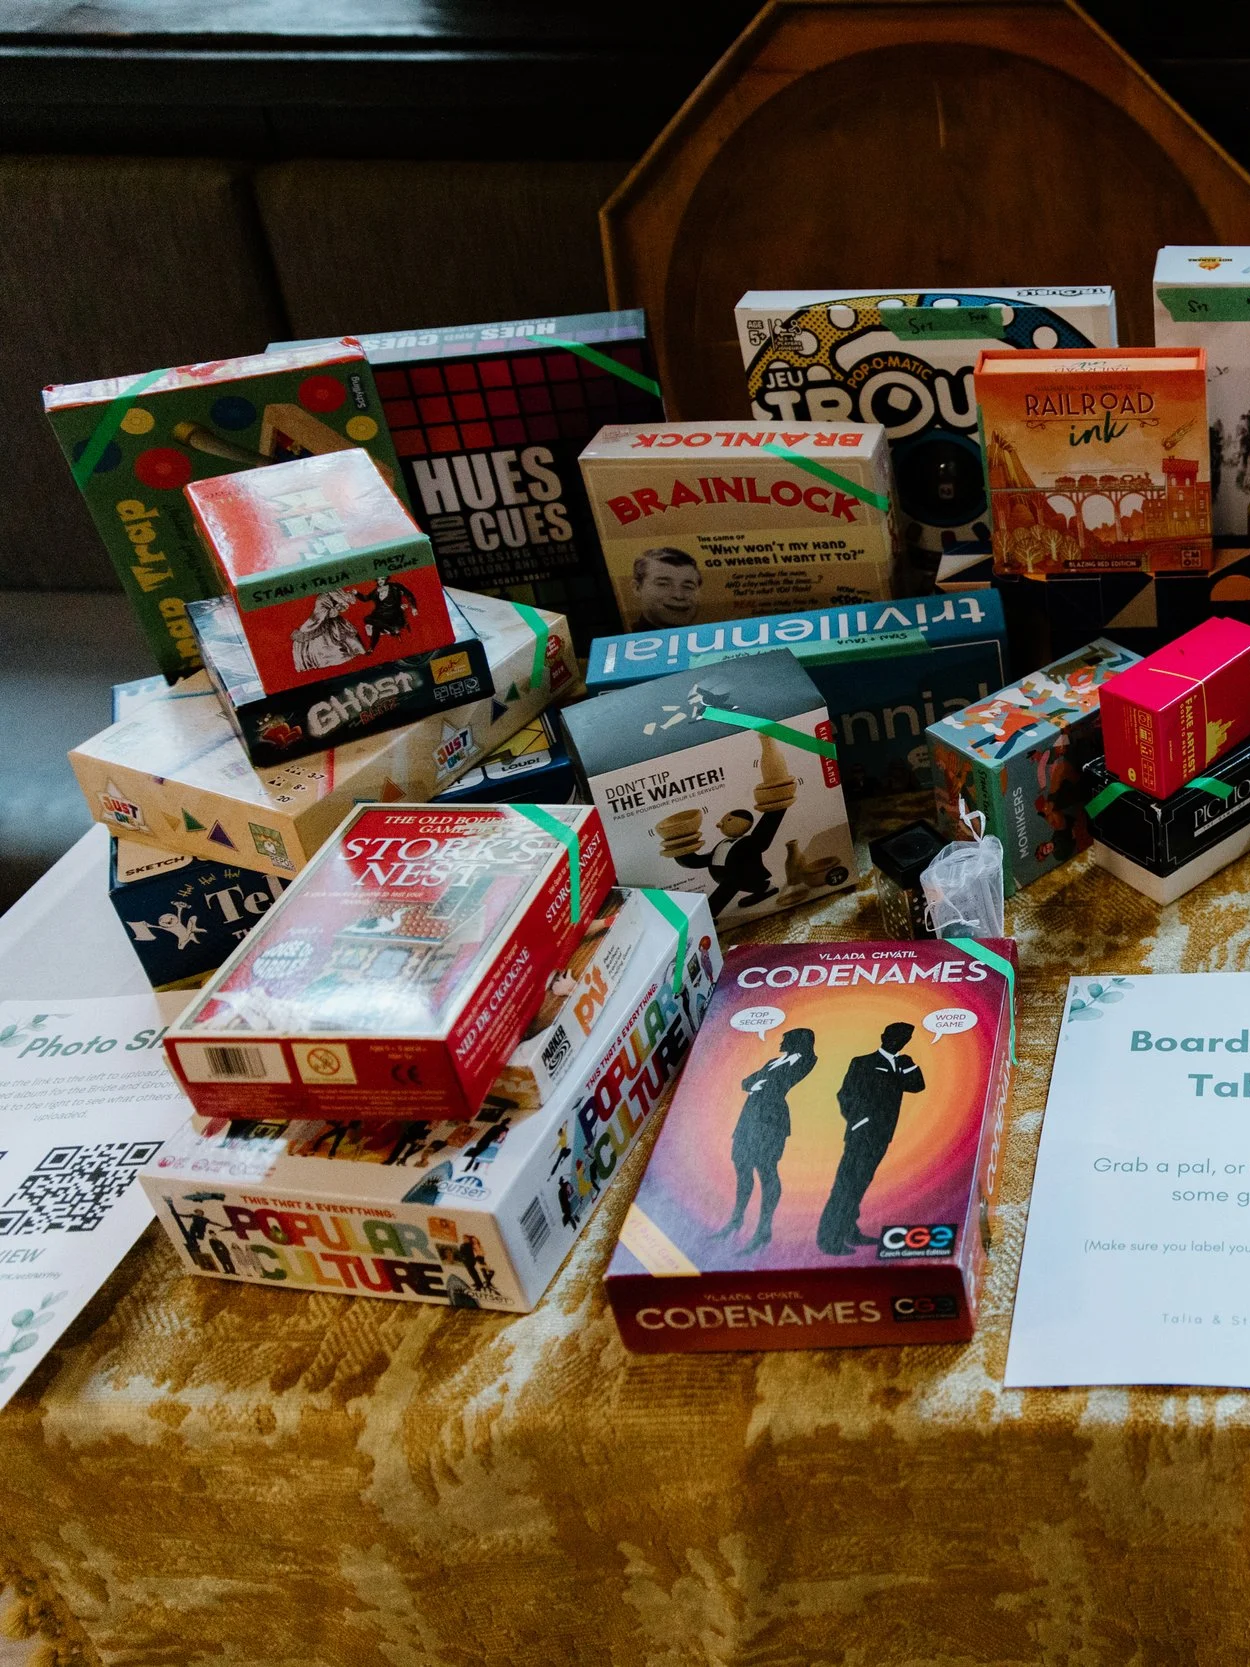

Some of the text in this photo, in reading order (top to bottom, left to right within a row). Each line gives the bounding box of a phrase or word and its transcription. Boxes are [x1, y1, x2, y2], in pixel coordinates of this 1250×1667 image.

[481, 322, 556, 339] HUES
[747, 320, 764, 329] AGE
[363, 334, 437, 350] CUES
[749, 330, 767, 346] 5+
[766, 370, 804, 389] JEU
[847, 358, 933, 389] POP-O-MATIC
[1025, 392, 1154, 416] RAILROAD
[631, 432, 865, 448] BRAINLOCK
[1069, 411, 1129, 447] ink
[412, 446, 562, 515] HUES
[607, 477, 861, 525] BRAINLOCK
[430, 515, 472, 555] AND
[469, 503, 573, 551] CUES
[116, 500, 174, 592] Trap
[602, 597, 987, 674] trivillennial
[306, 671, 418, 736] GHOST
[437, 730, 469, 765] JUST
[1186, 698, 1197, 773] FAKE ARTIST
[307, 772, 325, 781] 3-7
[501, 757, 541, 772] LOUD!
[605, 771, 671, 800] DON'T TIP
[607, 767, 726, 814] THE WAITER!
[103, 797, 139, 822] JUST
[384, 816, 452, 825] THE OLD
[1012, 786, 1029, 860] MONIKERS
[339, 837, 544, 863] STORK'S
[125, 856, 185, 877] SKETCH
[352, 862, 491, 887] NEST
[820, 949, 917, 961] VLAADA CHVÁTIL
[736, 960, 989, 989] CODENAMES
[456, 945, 532, 1060] NID DE CIGOGNE
[573, 964, 609, 1037] pit
[739, 1017, 776, 1026] SECRET
[749, 1011, 770, 1019] TOP
[935, 1021, 965, 1029] GAME
[936, 1013, 967, 1022] WORD
[17, 1026, 170, 1059] Photo Sh
[541, 1025, 568, 1064] PARKER
[577, 982, 679, 1145] POPULAR
[595, 1015, 693, 1181] CULTURE
[1093, 1157, 1148, 1173] Grab
[1156, 1162, 1169, 1173] a
[1178, 1158, 1216, 1178] pal,
[1224, 1162, 1245, 1175] or
[239, 1195, 266, 1205] THIS
[268, 1197, 302, 1209] THAT
[315, 1202, 397, 1220] EVERYTHING:
[1171, 1189, 1229, 1202] some
[224, 1205, 441, 1260] POPULAR
[880, 1247, 952, 1258] Czech Games Edition
[1084, 1239, 1126, 1253] (Make
[1130, 1242, 1159, 1252] sure
[1162, 1242, 1187, 1255] you
[1190, 1240, 1225, 1253] label
[249, 1244, 449, 1298] CULTURE
[704, 1293, 754, 1301] VLAADA
[635, 1301, 882, 1331] CODENAMES
[1162, 1313, 1203, 1325] Talia
[1212, 1314, 1221, 1325] &
